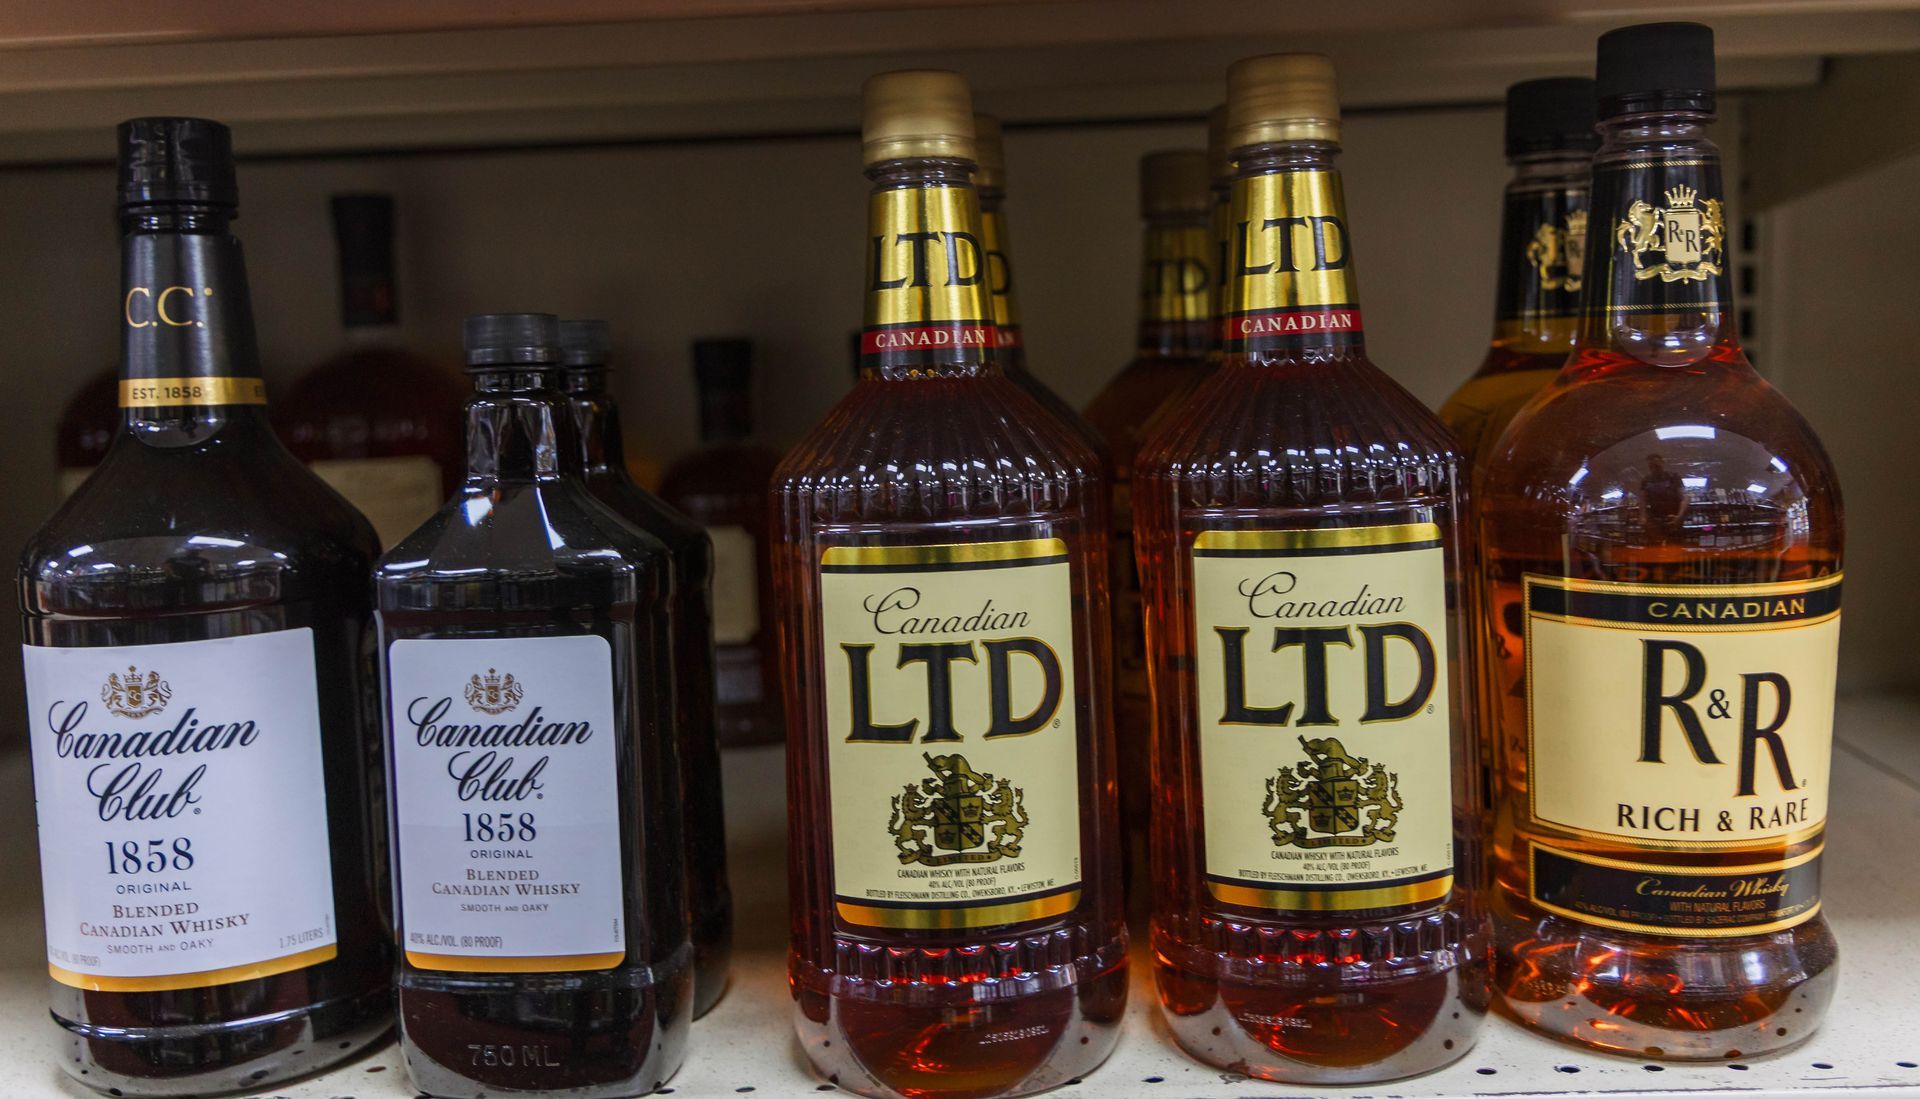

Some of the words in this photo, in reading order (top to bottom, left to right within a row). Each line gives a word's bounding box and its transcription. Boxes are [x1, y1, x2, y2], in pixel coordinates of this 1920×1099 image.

[1236, 215, 1350, 277] LTD
[872, 231, 984, 291] LTD
[1241, 313, 1352, 334] CANADIAN
[875, 329, 986, 348] CANADIAN
[132, 387, 160, 400] EST.
[164, 386, 202, 400] 1858
[1238, 571, 1406, 619] Canadian
[864, 587, 1031, 635] Canadian
[1647, 598, 1805, 620] CANADIAN
[1213, 620, 1438, 728] LTD
[840, 636, 1064, 744] LTD
[408, 696, 594, 748] Canadian
[1636, 637, 1801, 799] R&R
[48, 700, 261, 760] Canadian
[1617, 803, 1701, 832] RICH
[1716, 810, 1734, 832] &
[1750, 798, 1809, 831] RARE
[462, 812, 537, 842] 1858
[105, 836, 196, 875] 1858
[469, 849, 534, 860] ORIGINAL
[1271, 850, 1302, 860] CANADIAN
[1304, 851, 1327, 860] WHISKY
[1329, 851, 1345, 860] WITH
[1346, 849, 1373, 860] NATURAL
[1374, 847, 1399, 858] FLAVORS
[466, 867, 540, 881] BLENDED
[897, 868, 928, 879] CANADIAN
[929, 868, 954, 879] WHISKY
[955, 868, 970, 877] WITH
[971, 866, 999, 877] NATURAL
[1000, 862, 1025, 874] FLAVORS
[115, 879, 192, 895] ORIGINAL
[432, 882, 511, 897] CANADIAN
[515, 882, 580, 896] WHISKY
[865, 888, 886, 898] BOTTLED
[931, 890, 959, 900] DISTILLING
[1636, 877, 1728, 899] Canadian
[1729, 873, 1790, 898] Whisky
[112, 901, 199, 919] BLENDED
[460, 903, 501, 913] SMOOTH
[521, 903, 549, 913] OAKY
[1670, 901, 1693, 913] WITH
[1694, 902, 1730, 913] NATURAL
[1732, 899, 1766, 912] FLAVORS
[80, 921, 164, 938] CANADIAN
[170, 912, 251, 936] WHISKY
[298, 927, 324, 944] LITERS
[106, 943, 154, 955] SMOOTH
[157, 943, 176, 952] AND
[180, 937, 214, 951] OAKY
[474, 936, 503, 949] PROOF)
[467, 1044, 515, 1067] 750
[521, 1044, 561, 1067] ML
